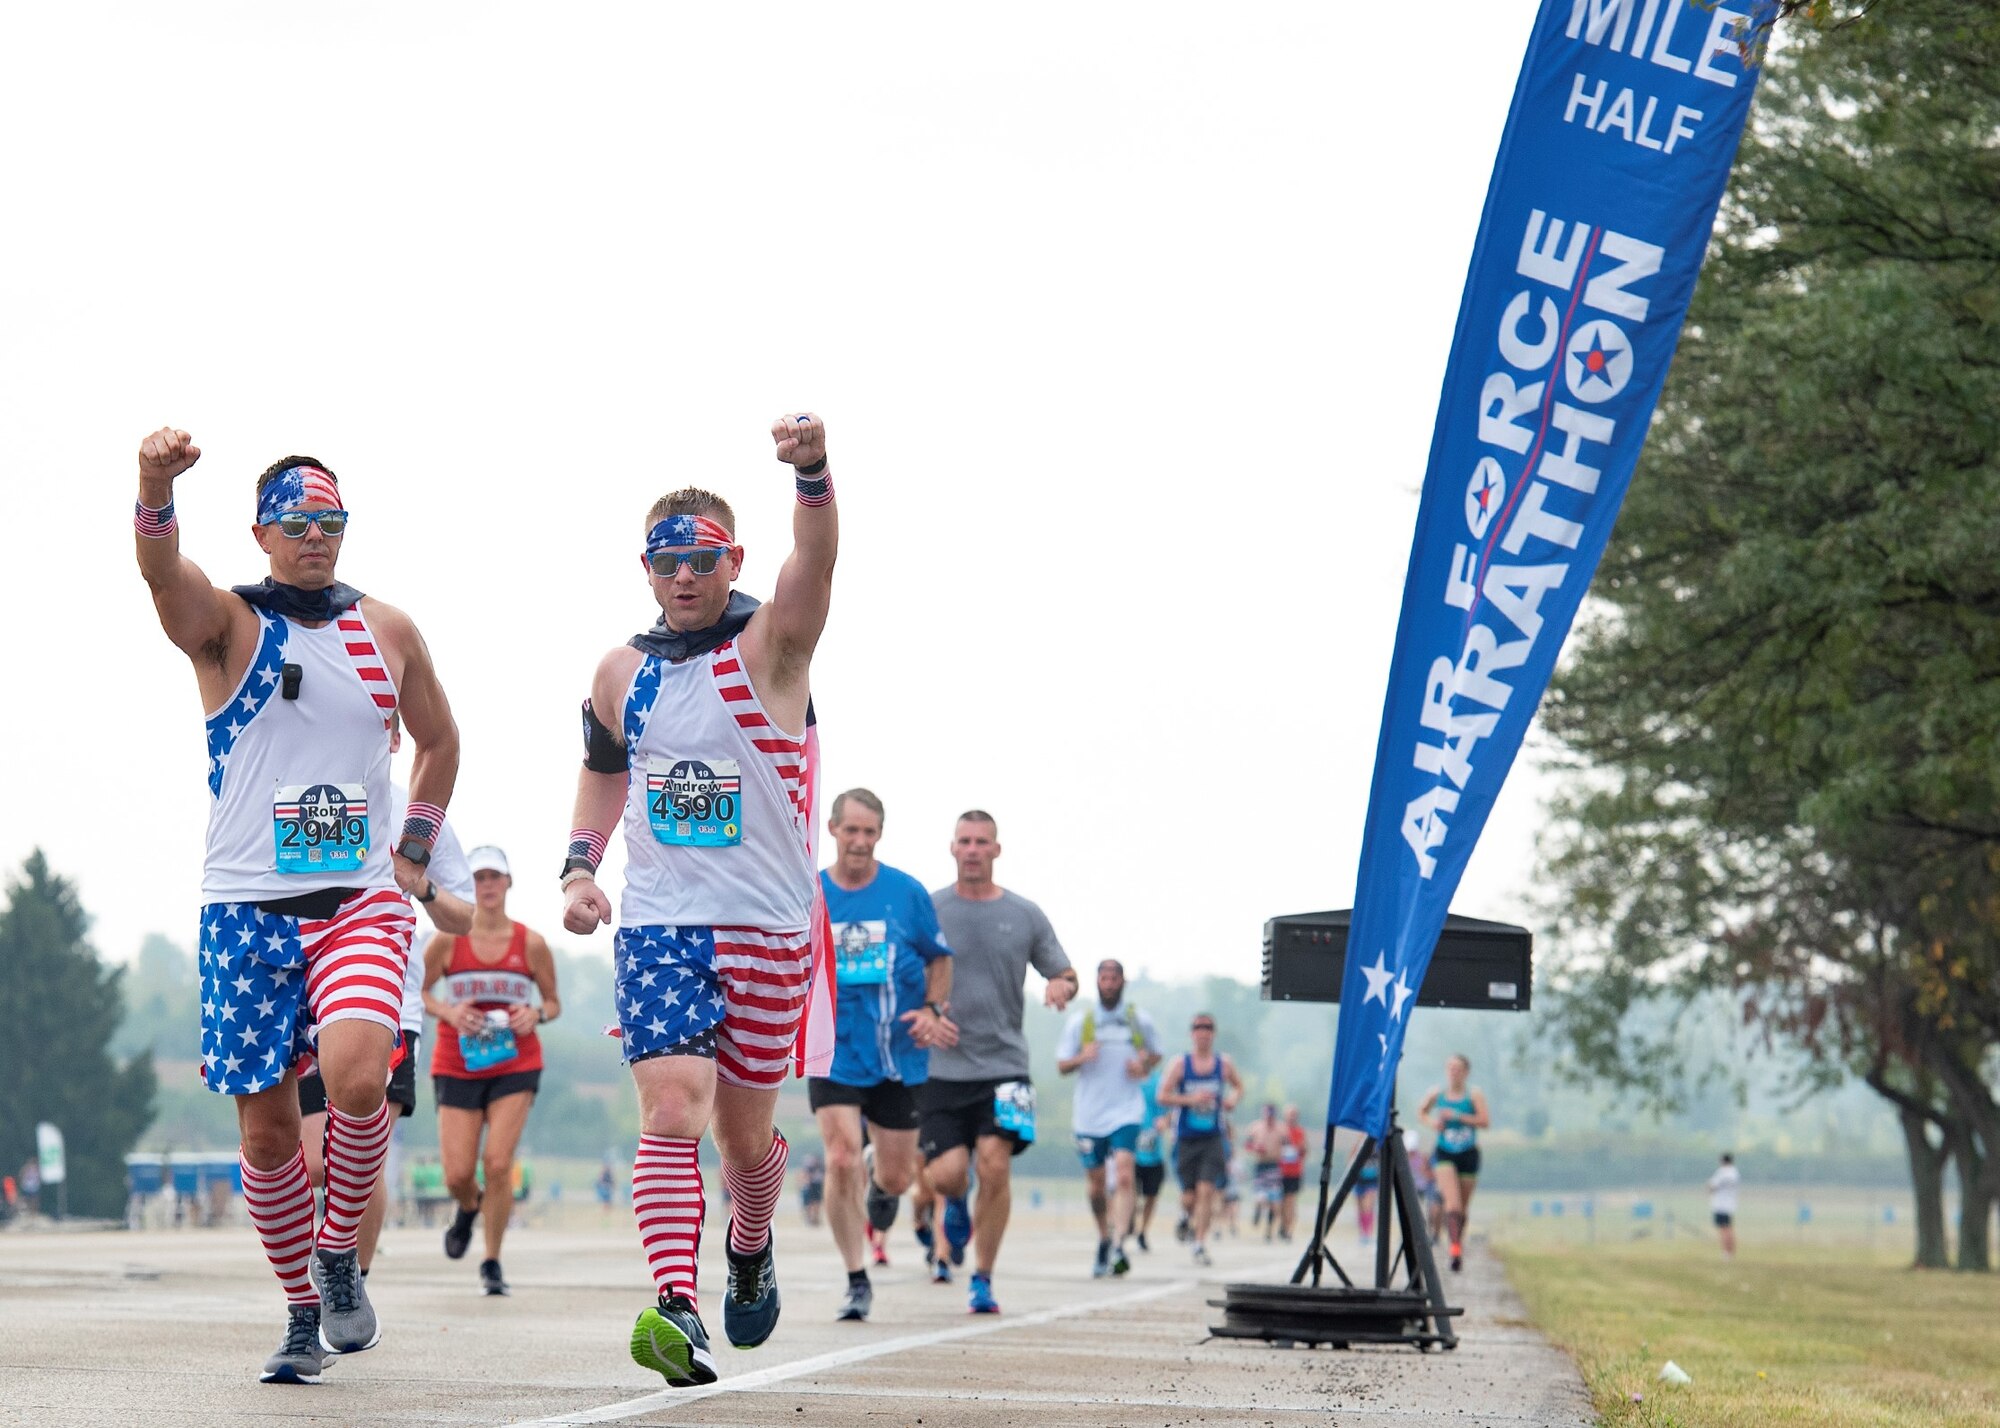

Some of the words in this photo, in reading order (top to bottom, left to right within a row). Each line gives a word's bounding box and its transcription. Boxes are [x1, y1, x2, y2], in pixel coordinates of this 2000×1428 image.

[1565, 0, 1754, 88] MILE
[1563, 72, 1705, 155] HALF
[1401, 655, 1458, 880] AIR
[1444, 207, 1592, 612] FORCE
[662, 779, 722, 792] Andrew
[674, 769, 685, 777] 20
[305, 794, 316, 802] 20
[330, 794, 340, 802] 19
[308, 806, 338, 817] Rob
[652, 793, 734, 821] 4590
[281, 818, 365, 848] 2949
